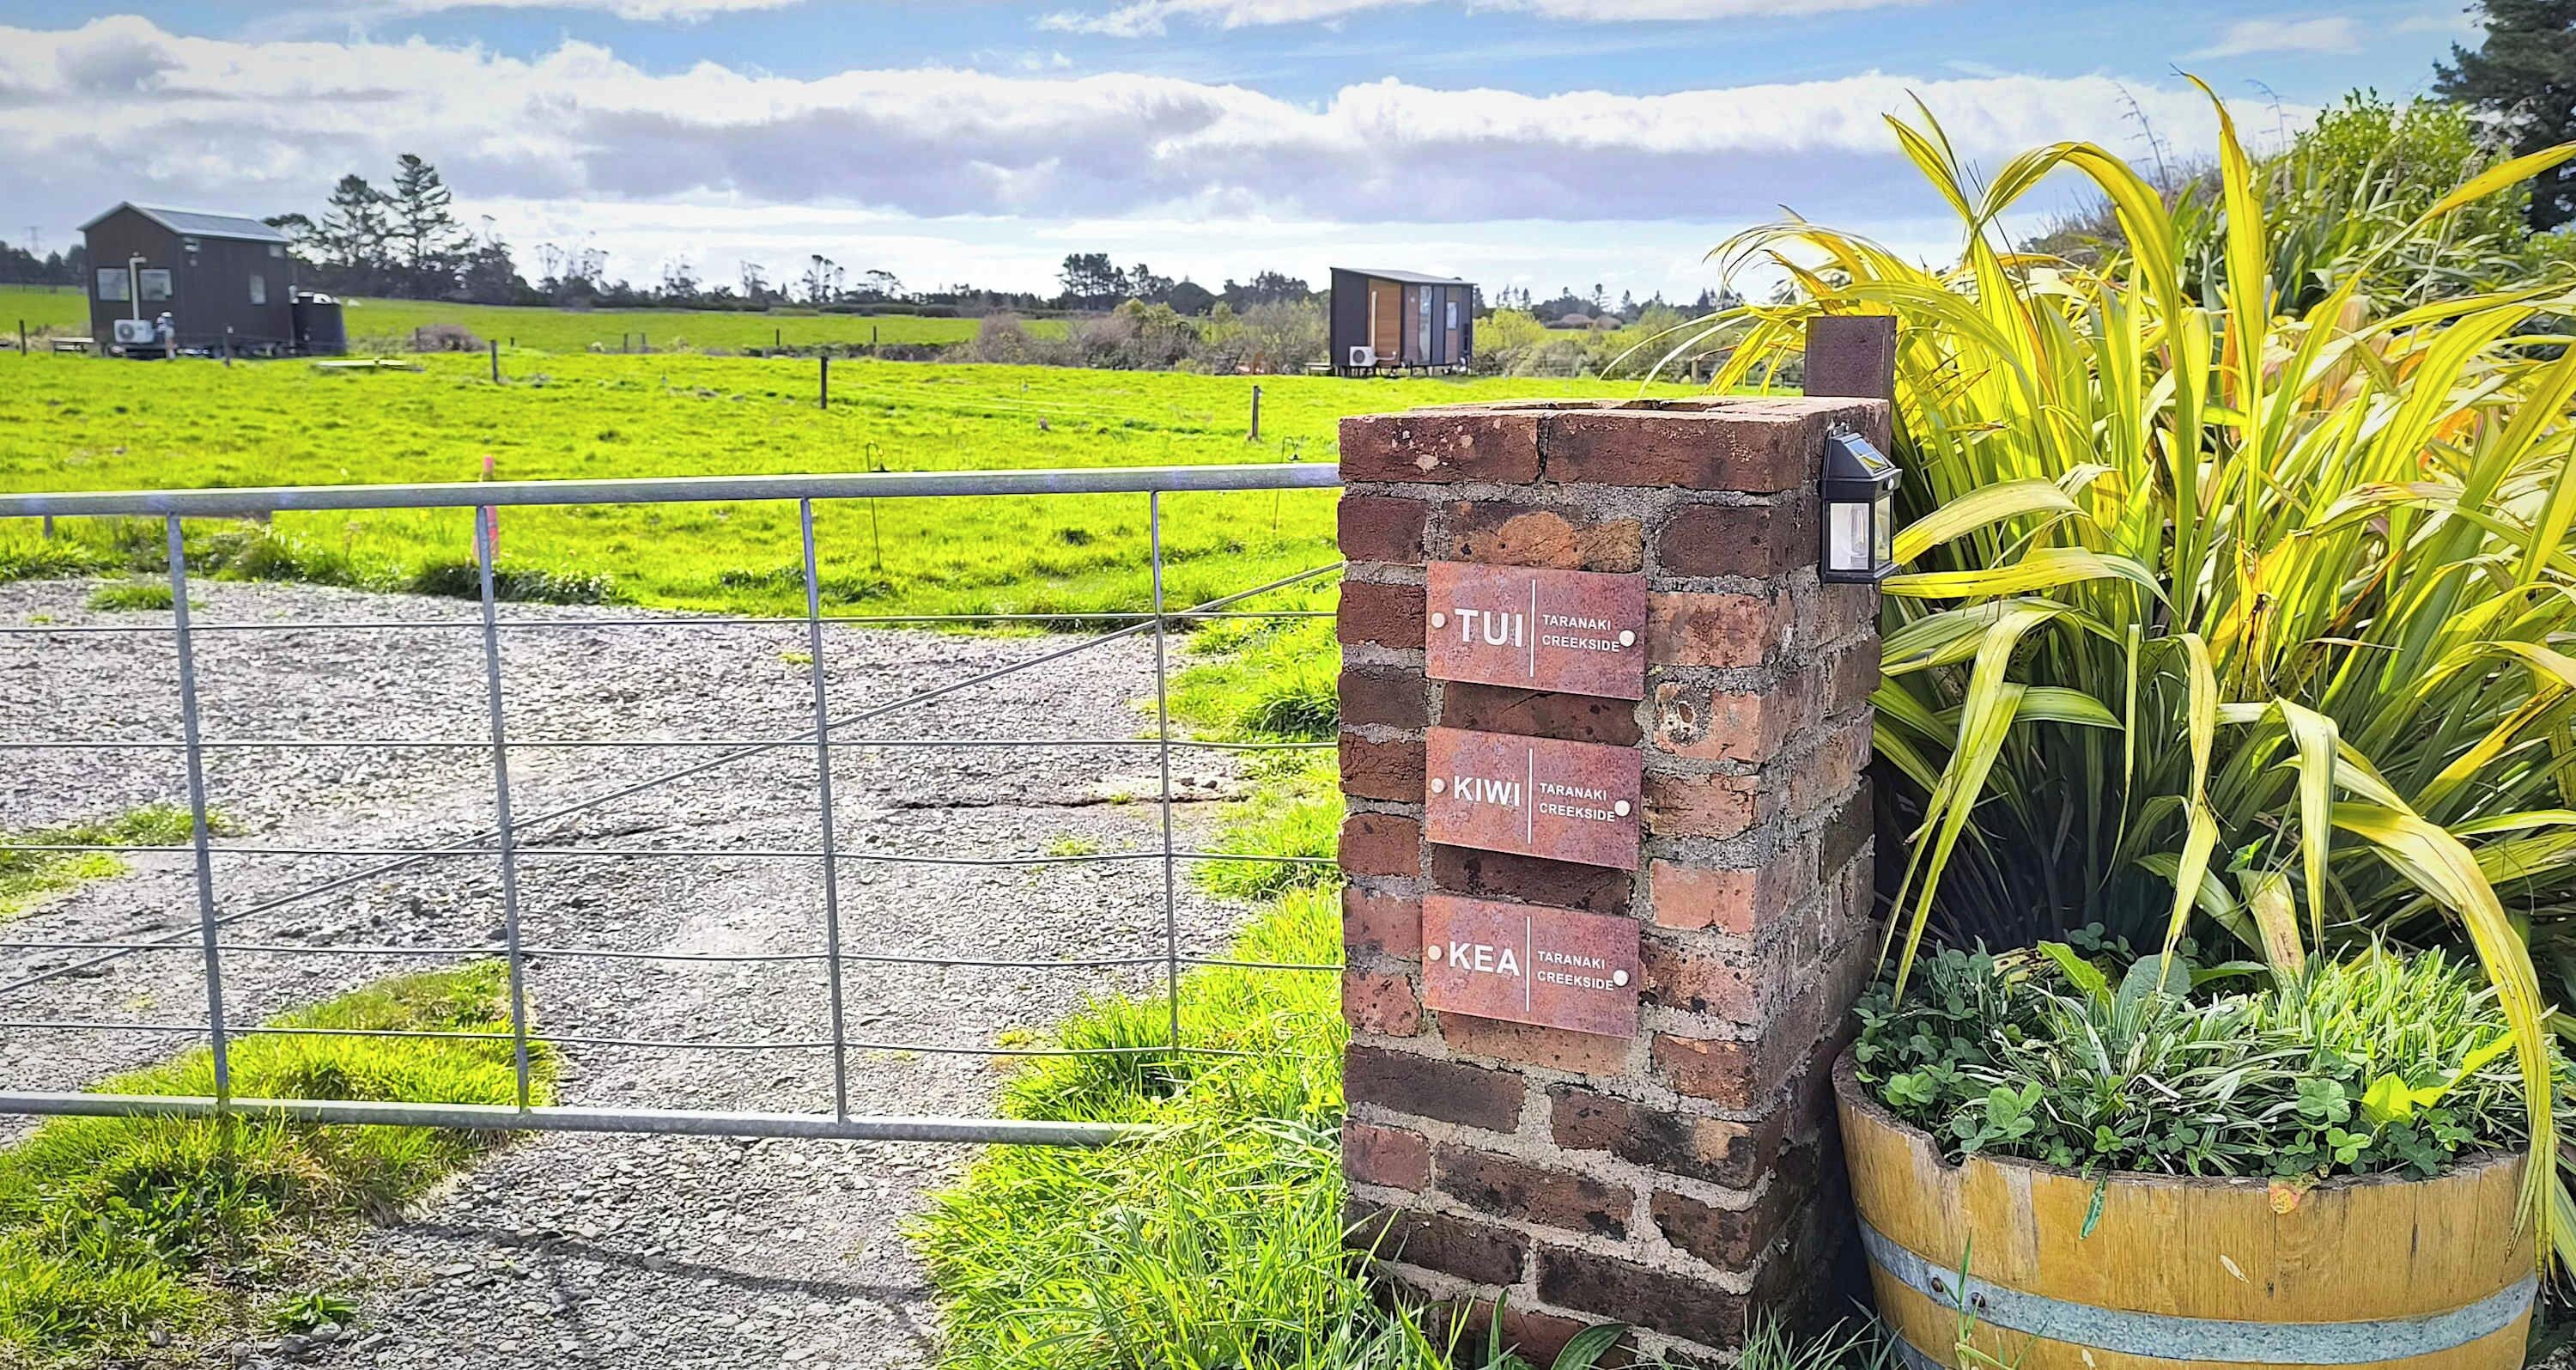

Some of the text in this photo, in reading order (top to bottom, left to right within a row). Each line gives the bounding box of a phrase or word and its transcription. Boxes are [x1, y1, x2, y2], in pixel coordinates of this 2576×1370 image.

[1455, 608, 1523, 648] TUI
[1542, 614, 1611, 630] TARANAKI
[1541, 635, 1620, 653] CREEKSIDE
[1454, 776, 1520, 807] KIWI
[1540, 782, 1607, 801] TARANAKI
[1539, 803, 1615, 822] CREEKSIDE
[1449, 941, 1520, 976] KEA
[1537, 951, 1605, 969] TARANAKI
[1537, 971, 1614, 990] CREEKSIDE
